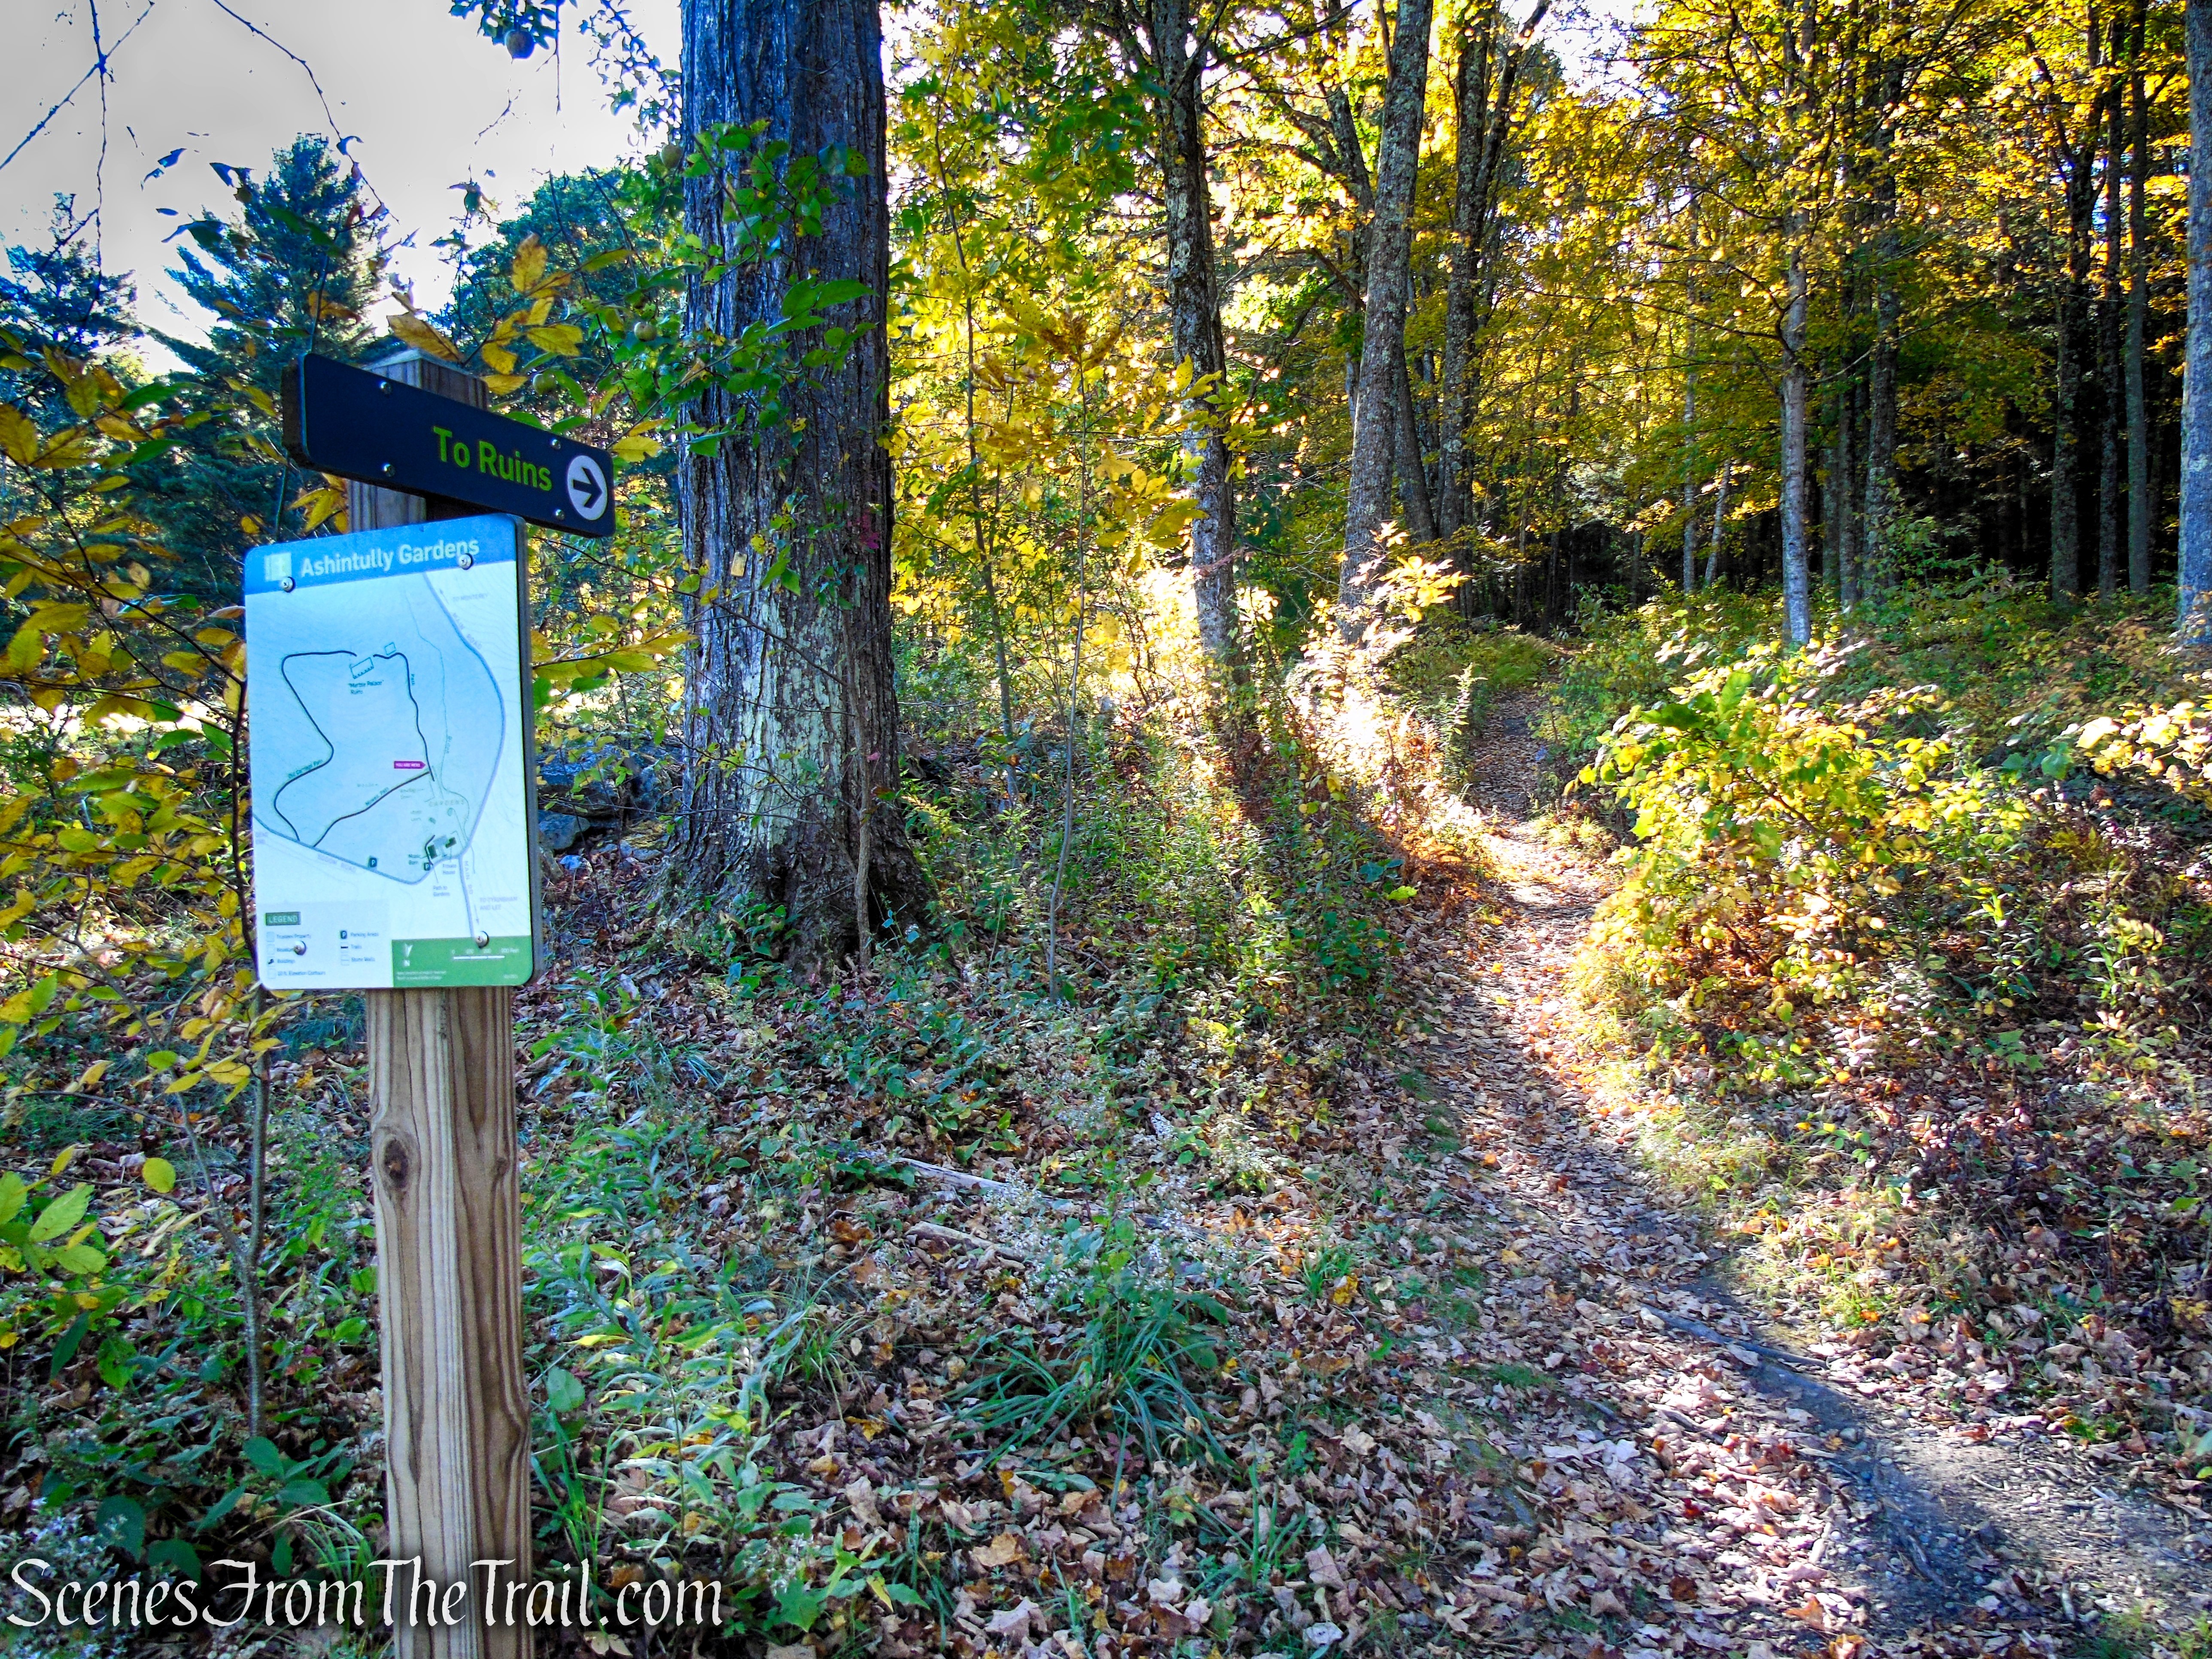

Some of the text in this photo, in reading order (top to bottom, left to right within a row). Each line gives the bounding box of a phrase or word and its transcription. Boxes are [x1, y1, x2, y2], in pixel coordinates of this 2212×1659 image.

[433, 425, 552, 492] To Ruins
[300, 548, 394, 578] Ashintully
[398, 538, 480, 565] Gardens
[269, 915, 298, 923] LEGEND
